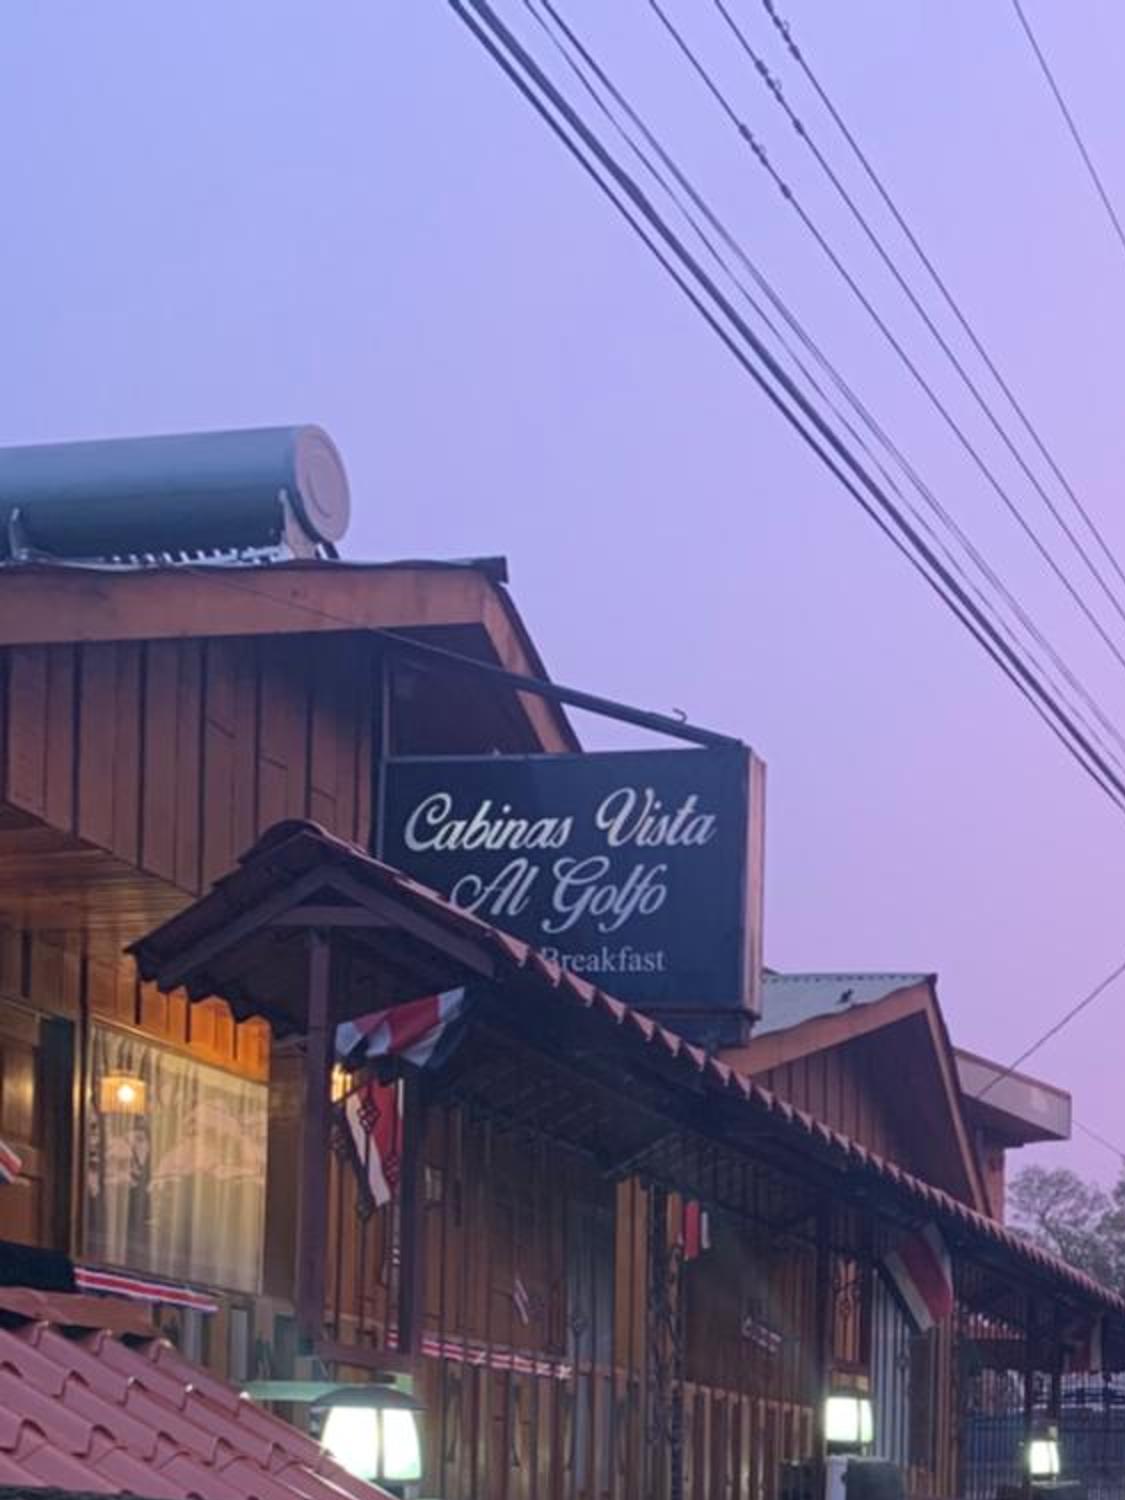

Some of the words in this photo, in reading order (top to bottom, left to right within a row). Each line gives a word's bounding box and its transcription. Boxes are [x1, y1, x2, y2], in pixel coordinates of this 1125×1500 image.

[404, 793, 574, 851] Cabinas
[595, 787, 716, 848] Vista
[449, 857, 540, 916] Al
[541, 855, 668, 934] Golfo
